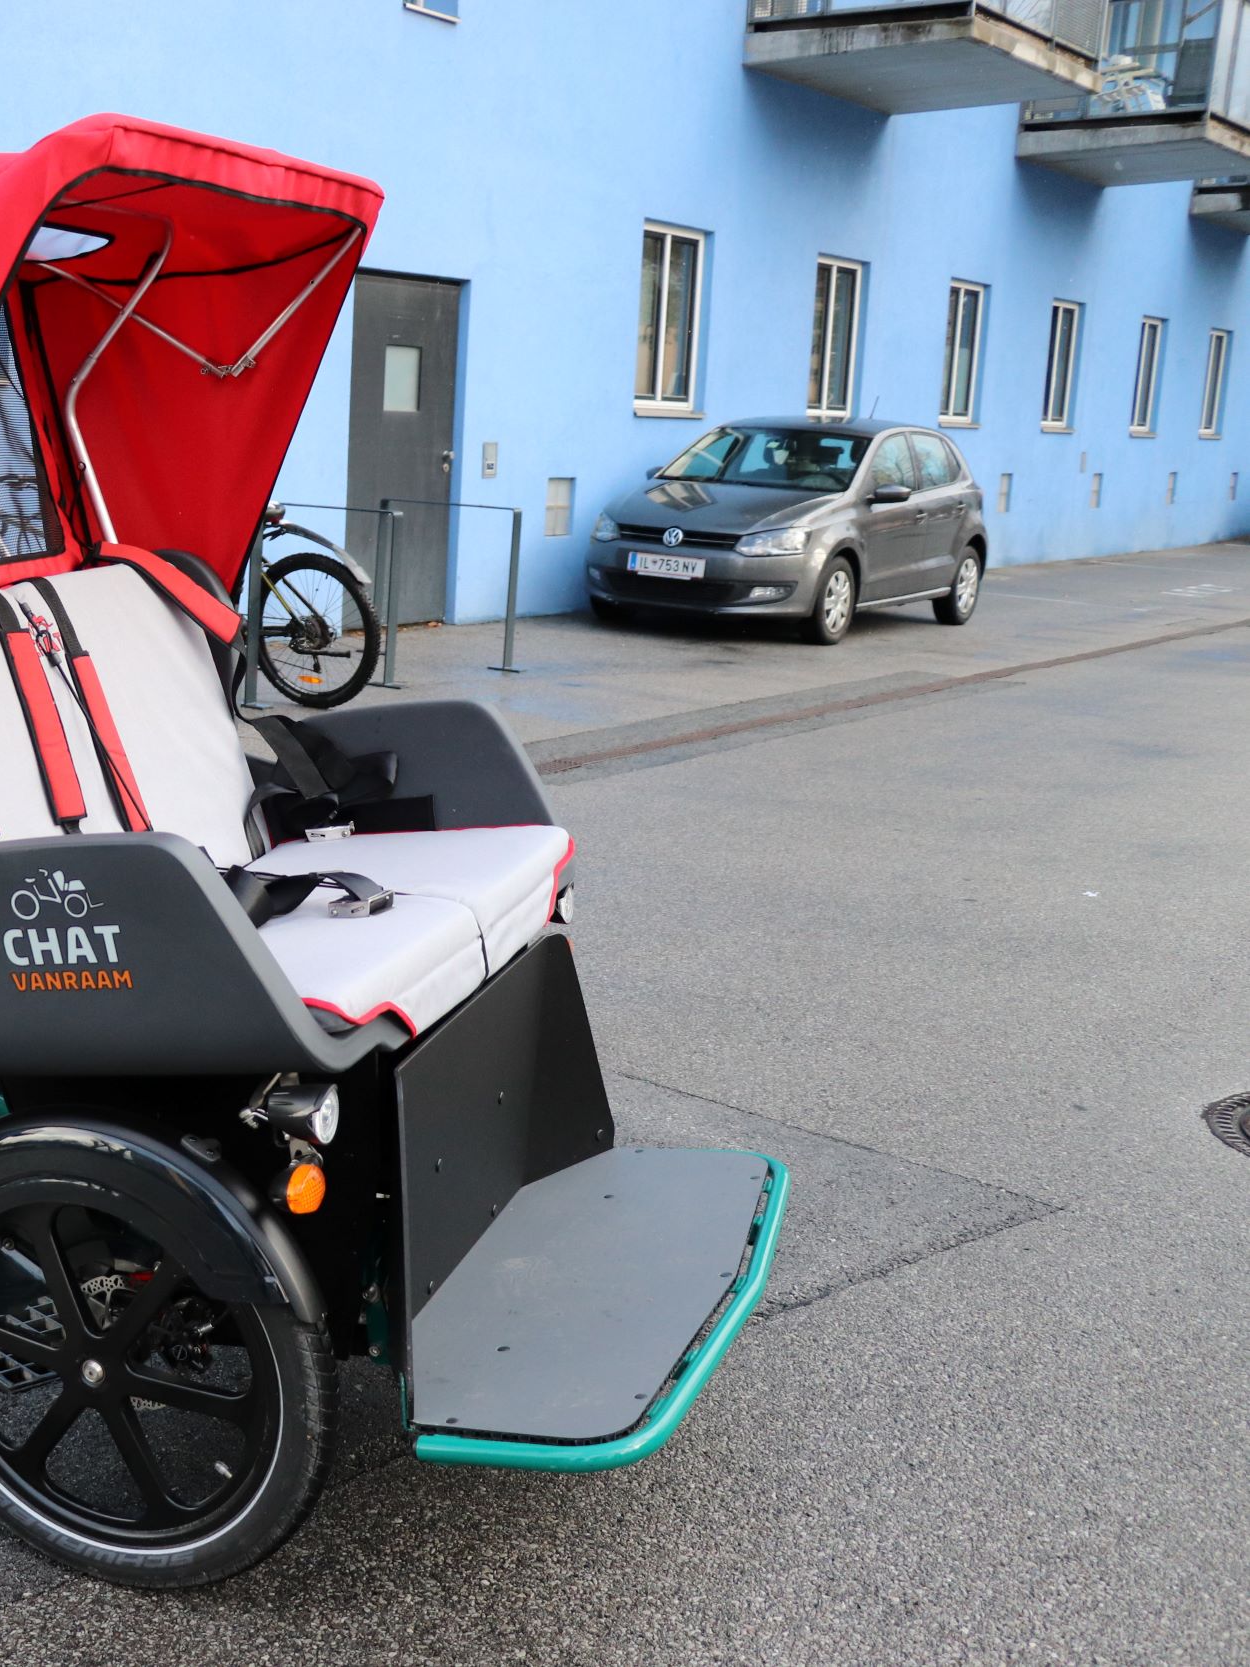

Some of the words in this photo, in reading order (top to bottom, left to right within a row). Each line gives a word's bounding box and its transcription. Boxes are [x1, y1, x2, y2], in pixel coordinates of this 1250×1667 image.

[657, 558, 680, 572] 753
[682, 561, 698, 573] NV
[3, 925, 121, 966] CHAT
[11, 969, 134, 991] VANRAAM
